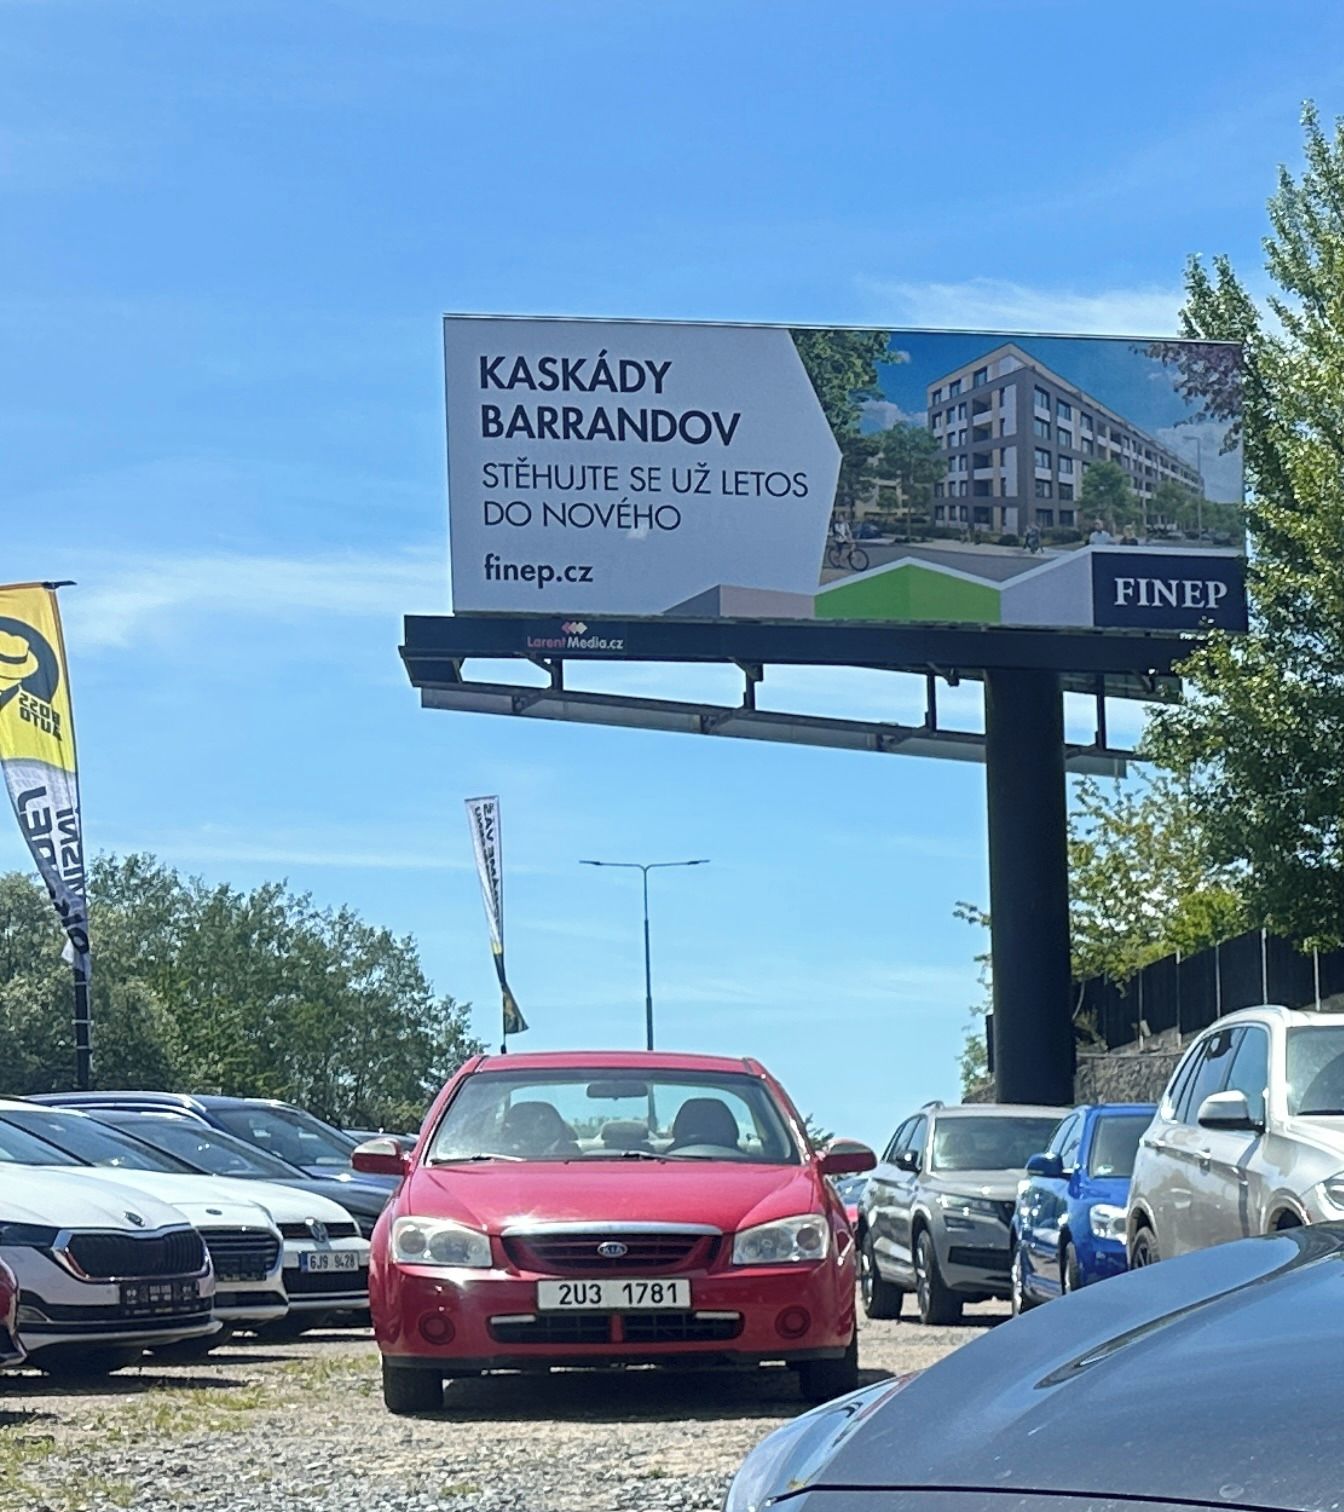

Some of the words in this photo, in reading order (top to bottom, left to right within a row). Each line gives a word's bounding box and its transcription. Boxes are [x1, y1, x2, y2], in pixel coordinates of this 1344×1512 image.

[480, 349, 673, 394] KASKÁDY
[481, 404, 742, 447] BARRANDOV
[482, 457, 619, 491] STĚHUJTE
[629, 466, 662, 492] SE
[672, 462, 712, 494] UŽ
[721, 470, 809, 498] LETOS
[484, 500, 532, 527] DO
[543, 497, 681, 531] NOVÉHO
[484, 553, 593, 589] finep.cz
[1114, 577, 1228, 609] FINEP
[527, 636, 624, 650] LarentMedia.cz
[558, 1283, 602, 1305] 2U3
[622, 1282, 678, 1304] 1781
